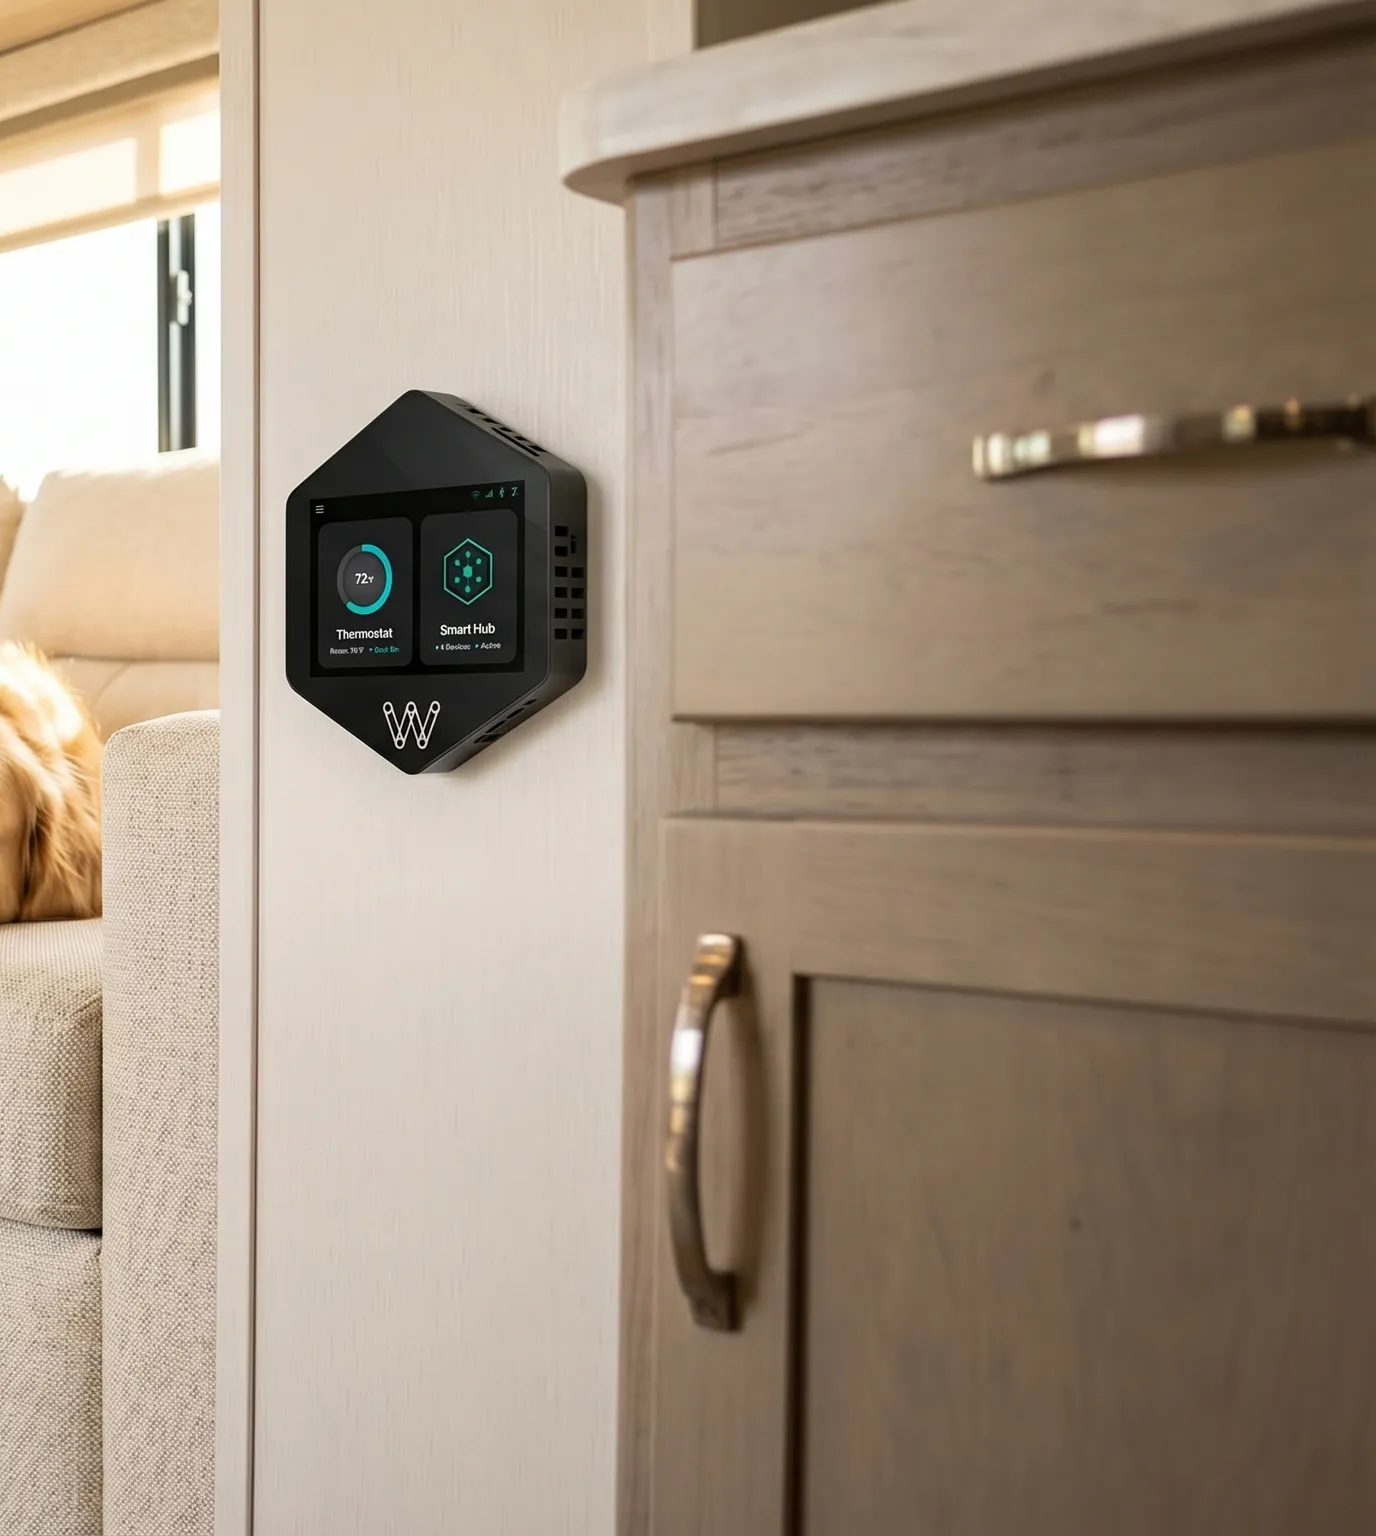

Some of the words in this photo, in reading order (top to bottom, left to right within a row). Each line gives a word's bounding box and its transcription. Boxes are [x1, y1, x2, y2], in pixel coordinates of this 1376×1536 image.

[336, 628, 394, 640] Thermostat
[440, 623, 472, 636] Smart
[473, 622, 496, 635] Hub
[383, 701, 441, 750] W
